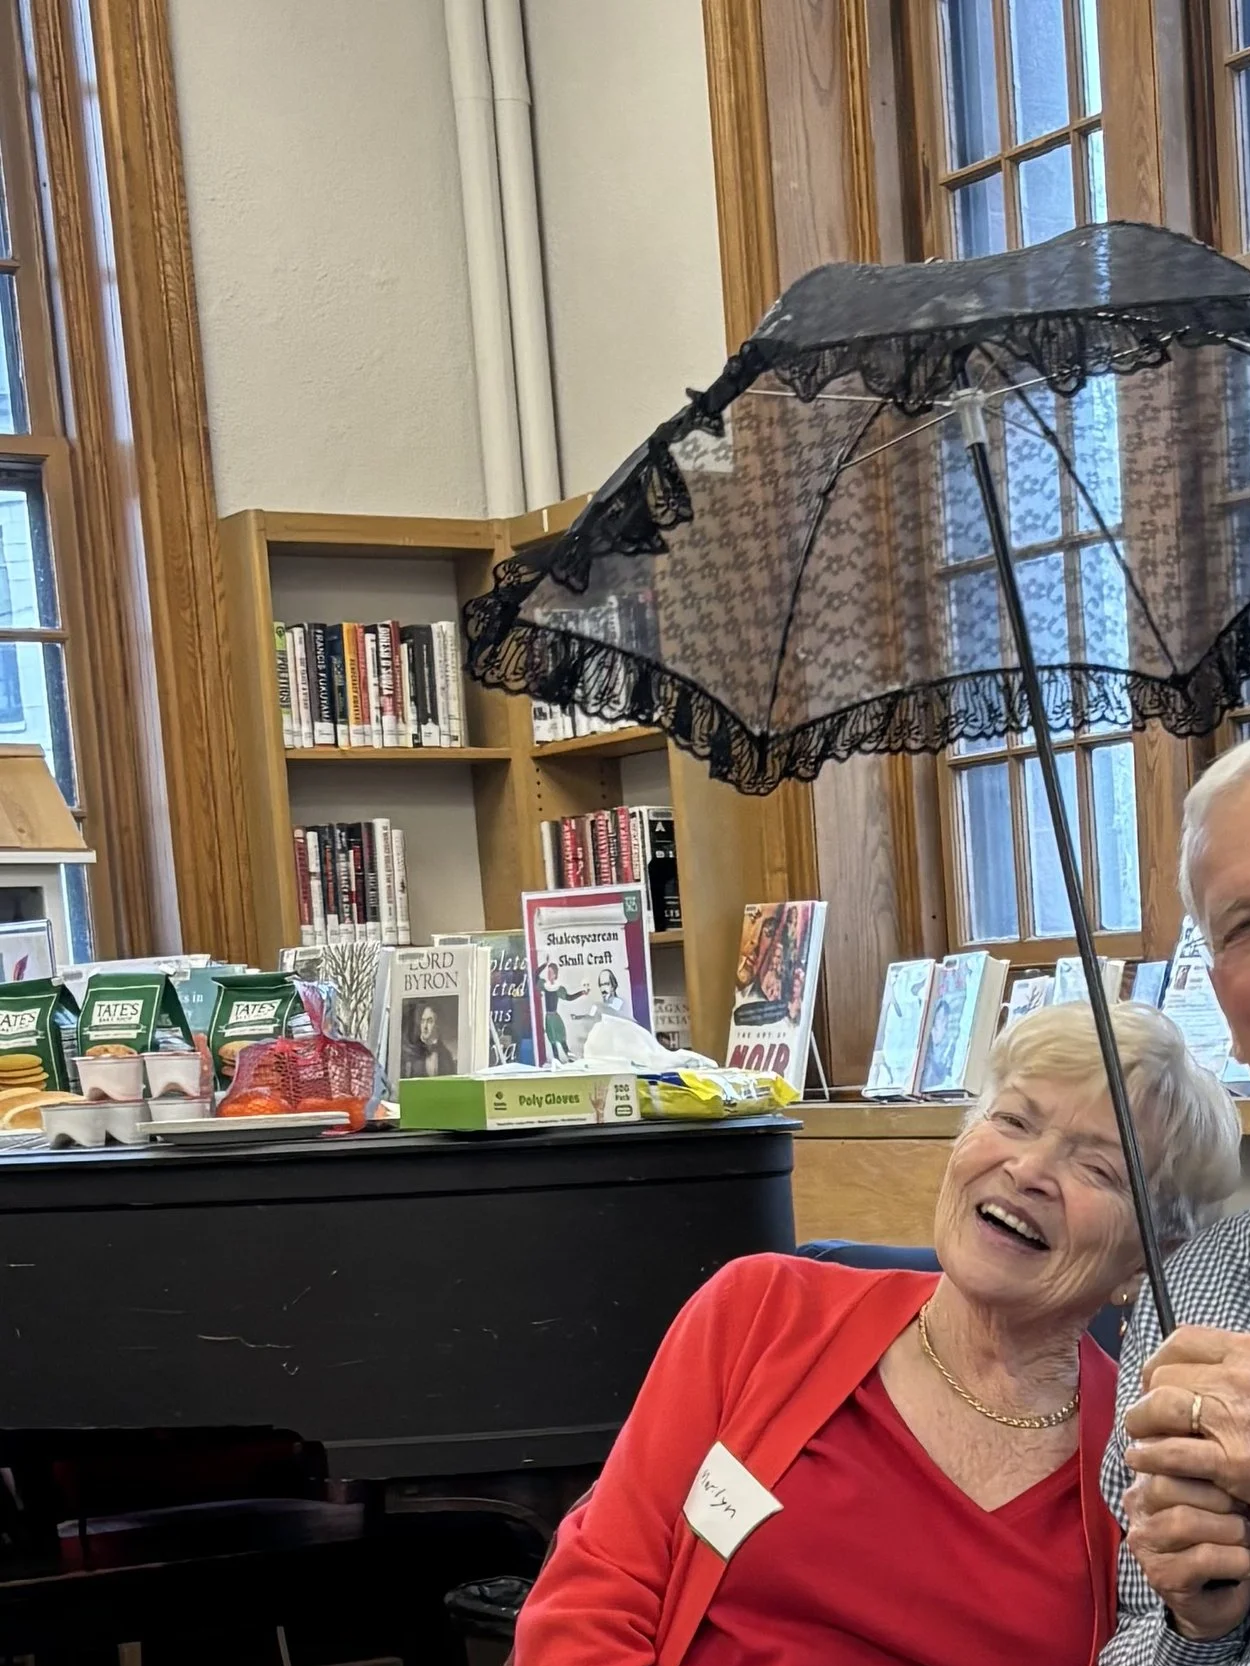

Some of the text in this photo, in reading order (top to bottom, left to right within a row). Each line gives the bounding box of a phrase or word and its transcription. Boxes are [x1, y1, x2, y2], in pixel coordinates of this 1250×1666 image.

[546, 931, 619, 948] Shakespearean
[410, 952, 455, 970] LORD
[403, 971, 459, 991] BYRON
[96, 1002, 139, 1017] TATE'S
[234, 1001, 277, 1016] TATE'S
[0, 1012, 36, 1028] ATE'S
[519, 1093, 580, 1108] Poly Gloves
